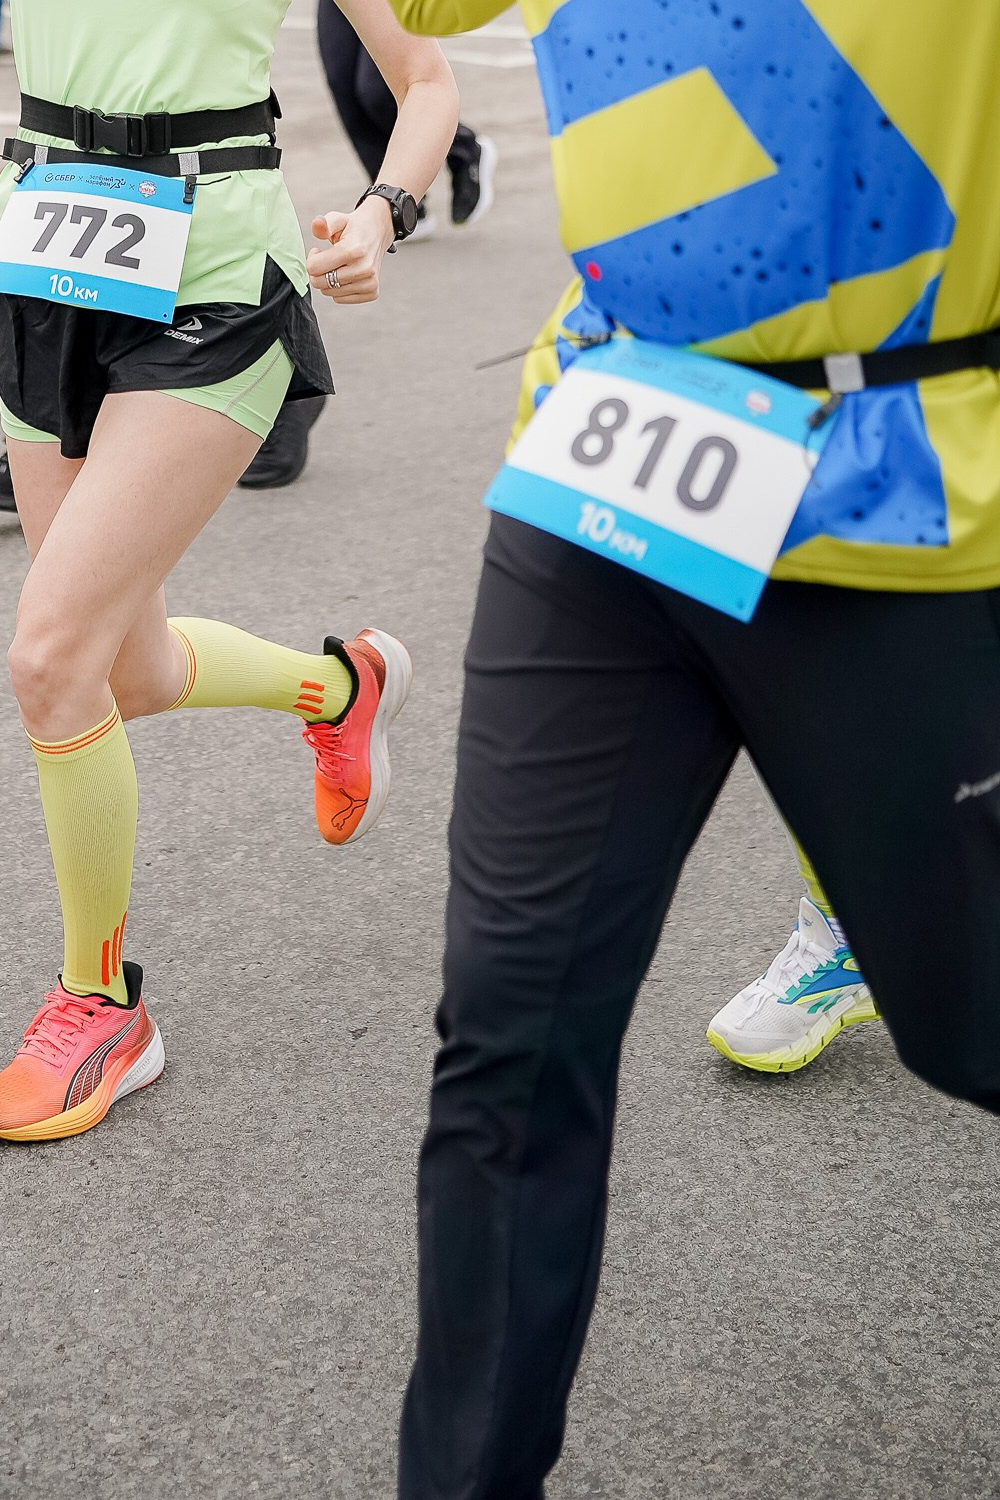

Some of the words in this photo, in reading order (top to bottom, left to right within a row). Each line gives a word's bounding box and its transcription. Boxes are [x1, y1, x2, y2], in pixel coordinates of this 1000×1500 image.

[54, 174, 76, 182] СБЕР
[32, 202, 146, 270] 772
[50, 274, 73, 296] 10
[163, 329, 204, 345] DEMIX
[571, 398, 738, 511] 810
[577, 501, 616, 543] 10
